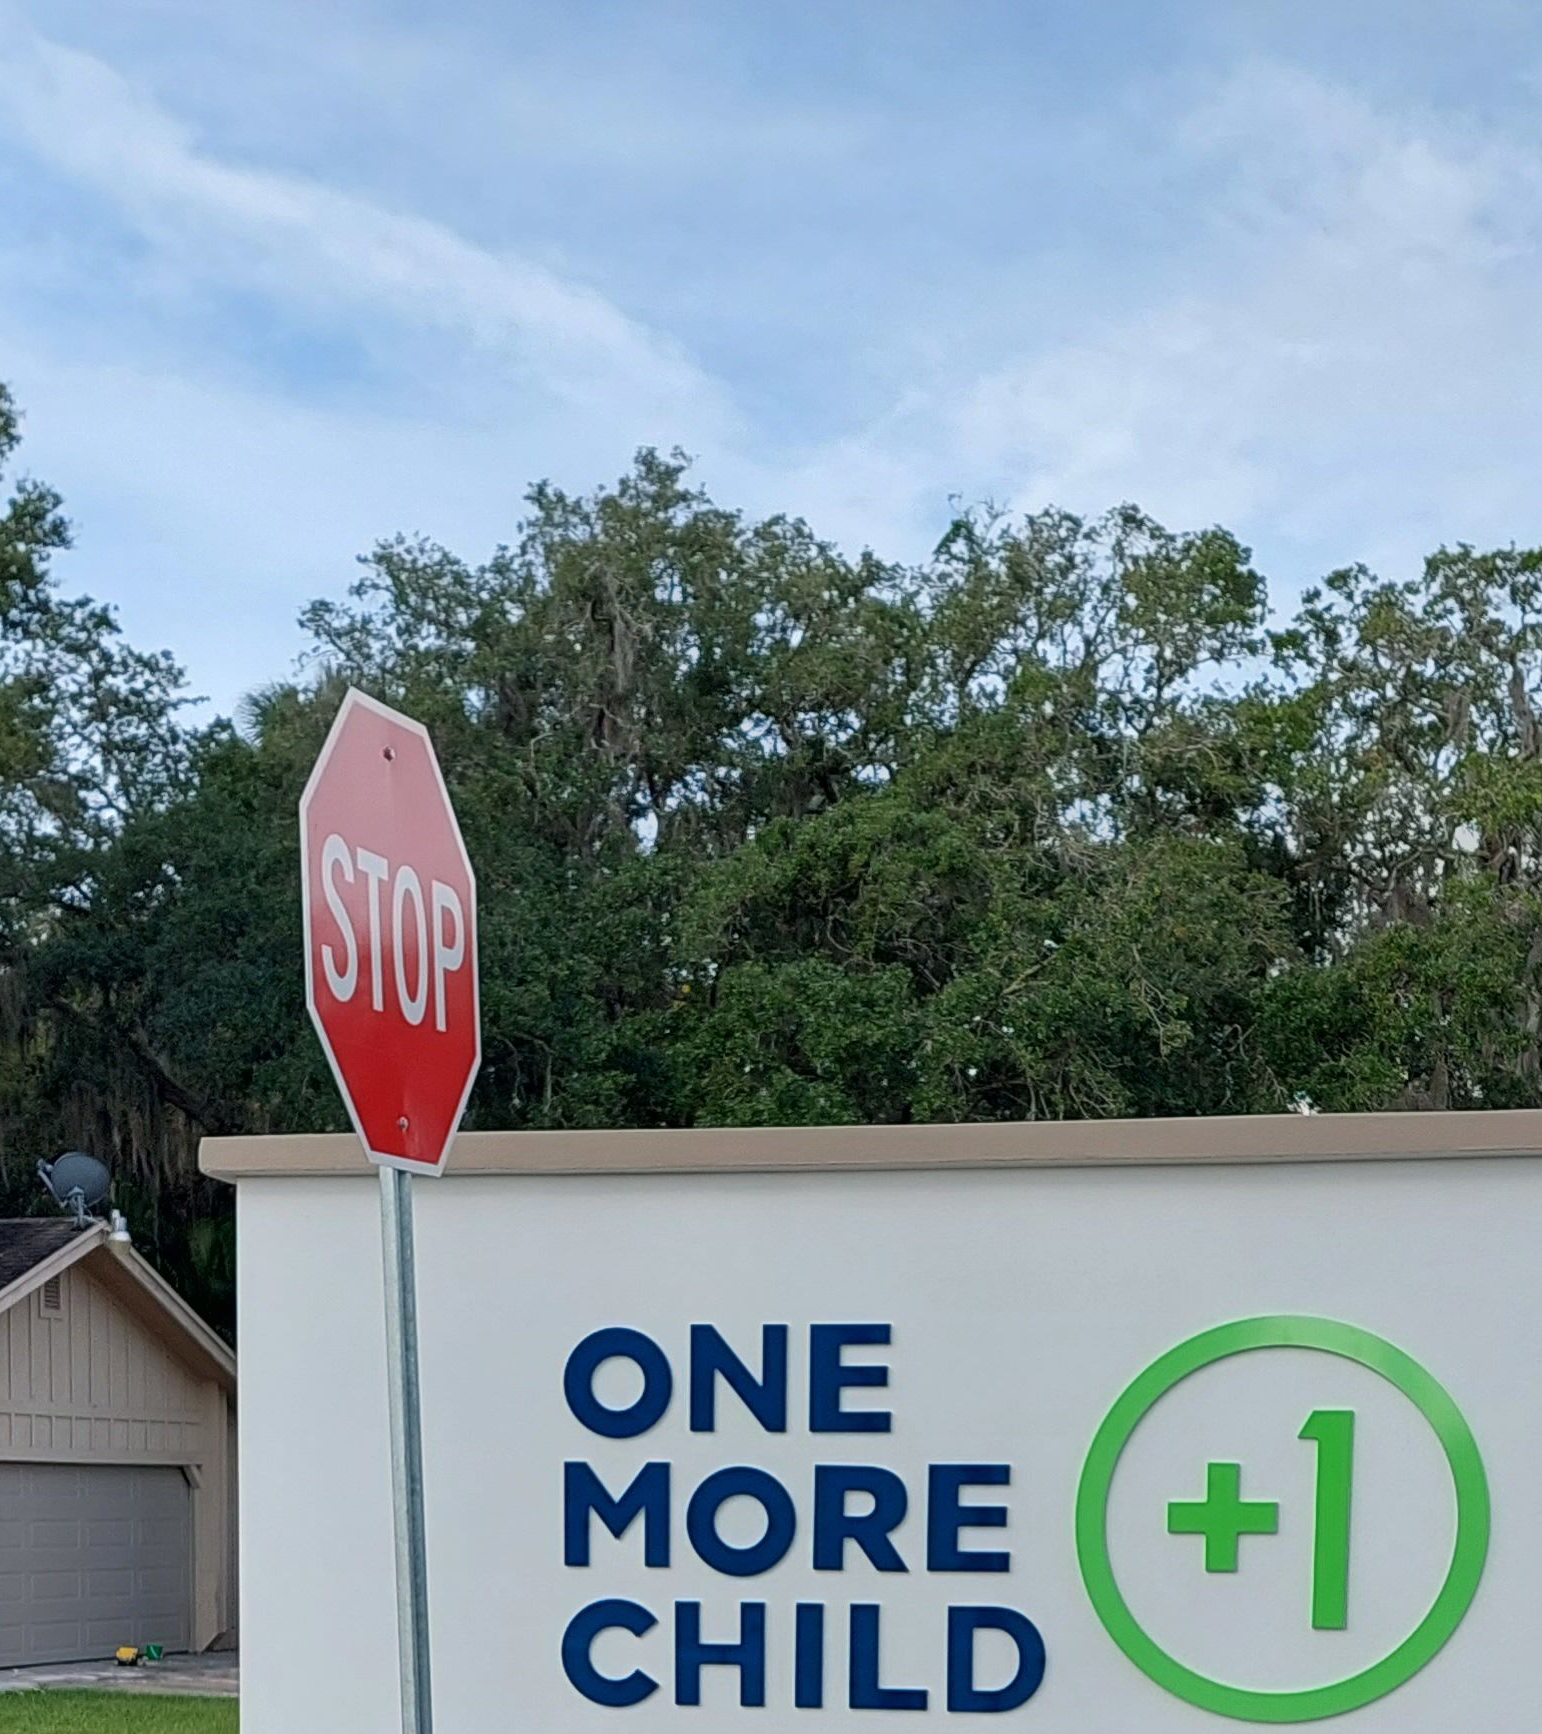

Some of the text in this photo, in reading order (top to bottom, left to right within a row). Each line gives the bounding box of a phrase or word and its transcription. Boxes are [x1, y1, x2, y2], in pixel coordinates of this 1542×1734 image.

[320, 833, 465, 1033] STOP
[563, 1323, 893, 1440] ONE
[563, 1461, 1012, 1579] MORE
[1167, 1410, 1356, 1632] +1
[561, 1598, 1047, 1714] CHILD
